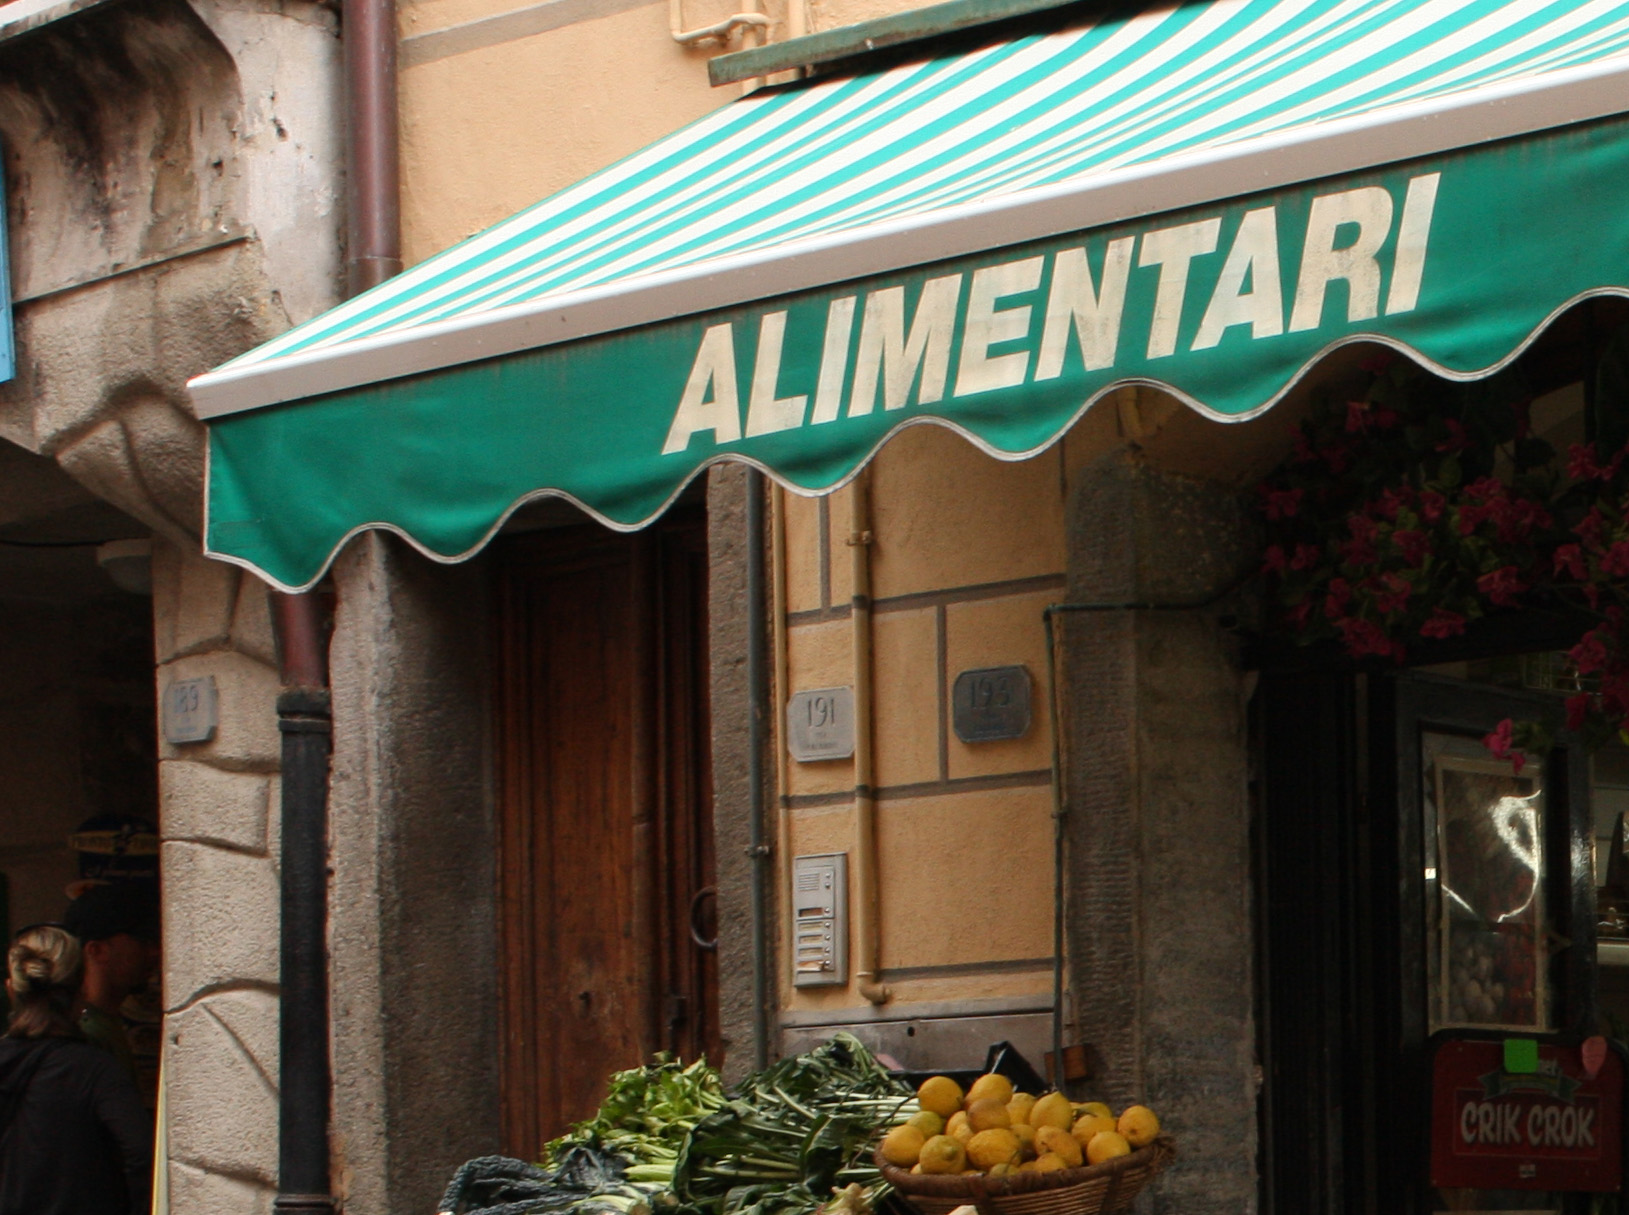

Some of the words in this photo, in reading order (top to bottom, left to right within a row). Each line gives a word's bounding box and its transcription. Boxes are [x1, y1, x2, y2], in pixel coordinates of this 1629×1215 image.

[661, 171, 1441, 456] ALIMENTARI
[807, 697, 835, 728] 191
[1460, 1101, 1522, 1147] CRIK
[1527, 1102, 1596, 1148] CROK
